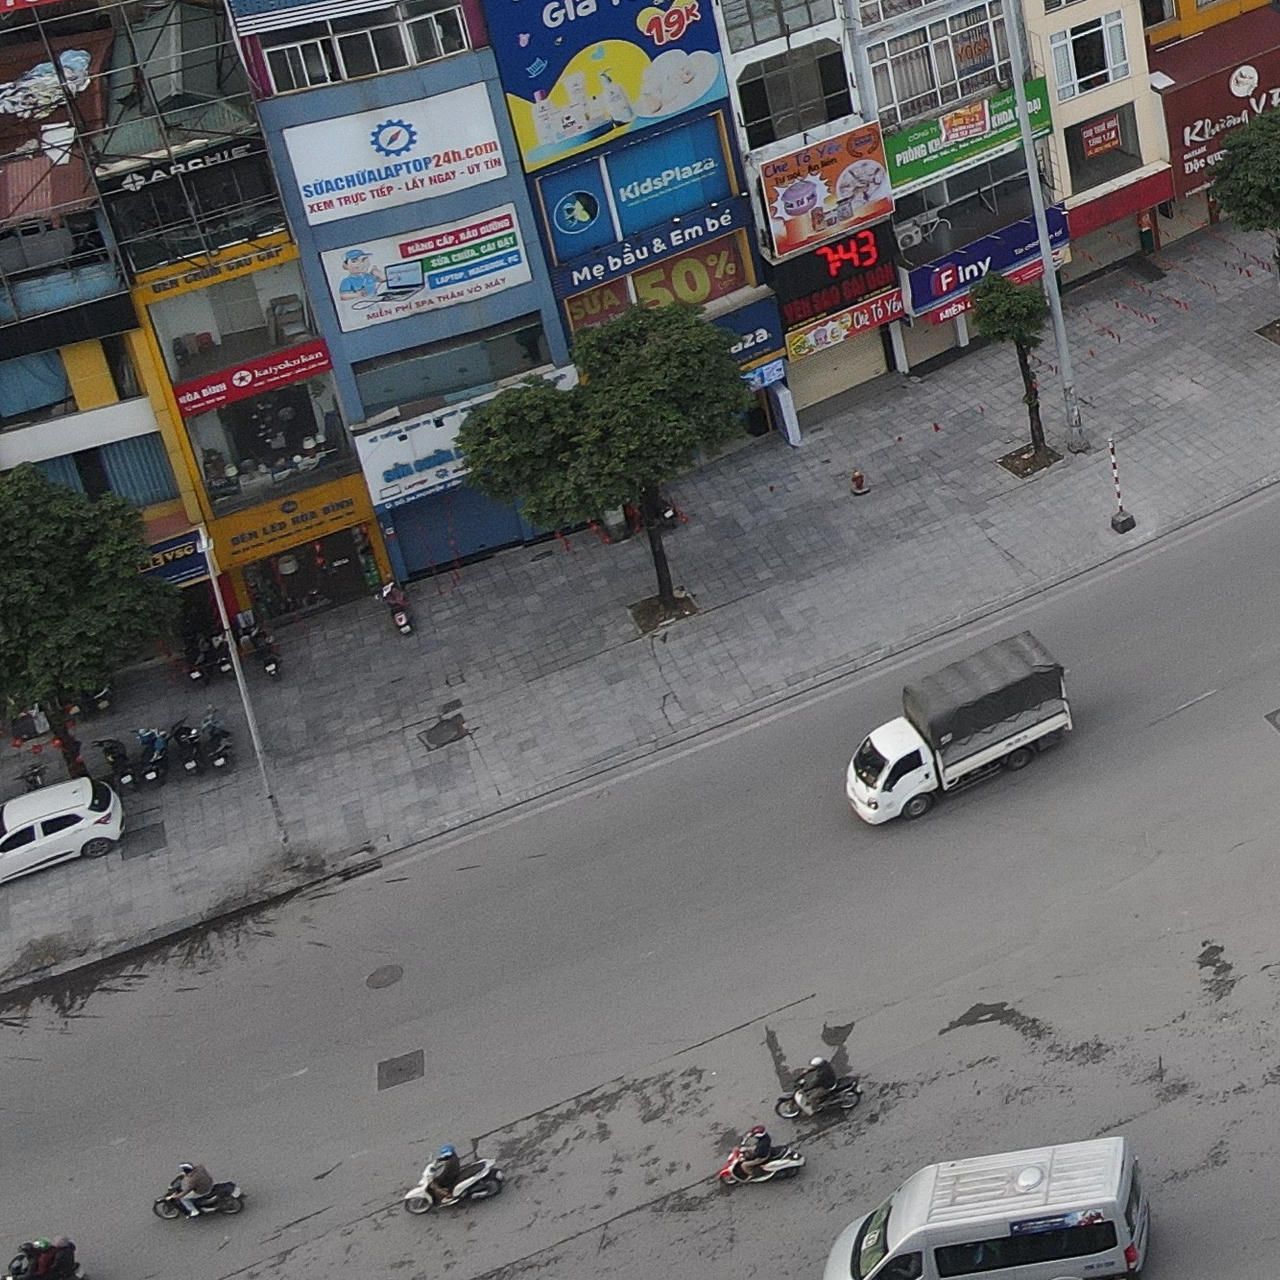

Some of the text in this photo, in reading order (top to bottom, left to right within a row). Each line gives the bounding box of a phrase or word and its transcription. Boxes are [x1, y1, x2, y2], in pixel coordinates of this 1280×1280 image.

[894, 144, 928, 168] PHÒNG
[991, 107, 1015, 129] KHOA
[307, 199, 335, 214] XEM
[338, 190, 368, 207] TRỰC
[368, 183, 394, 201] TIẾP
[429, 169, 457, 187] NGAY
[618, 157, 716, 203] KidsPlaza
[571, 208, 733, 288] Mẹ bầu & Em bé
[414, 297, 435, 310] SPA
